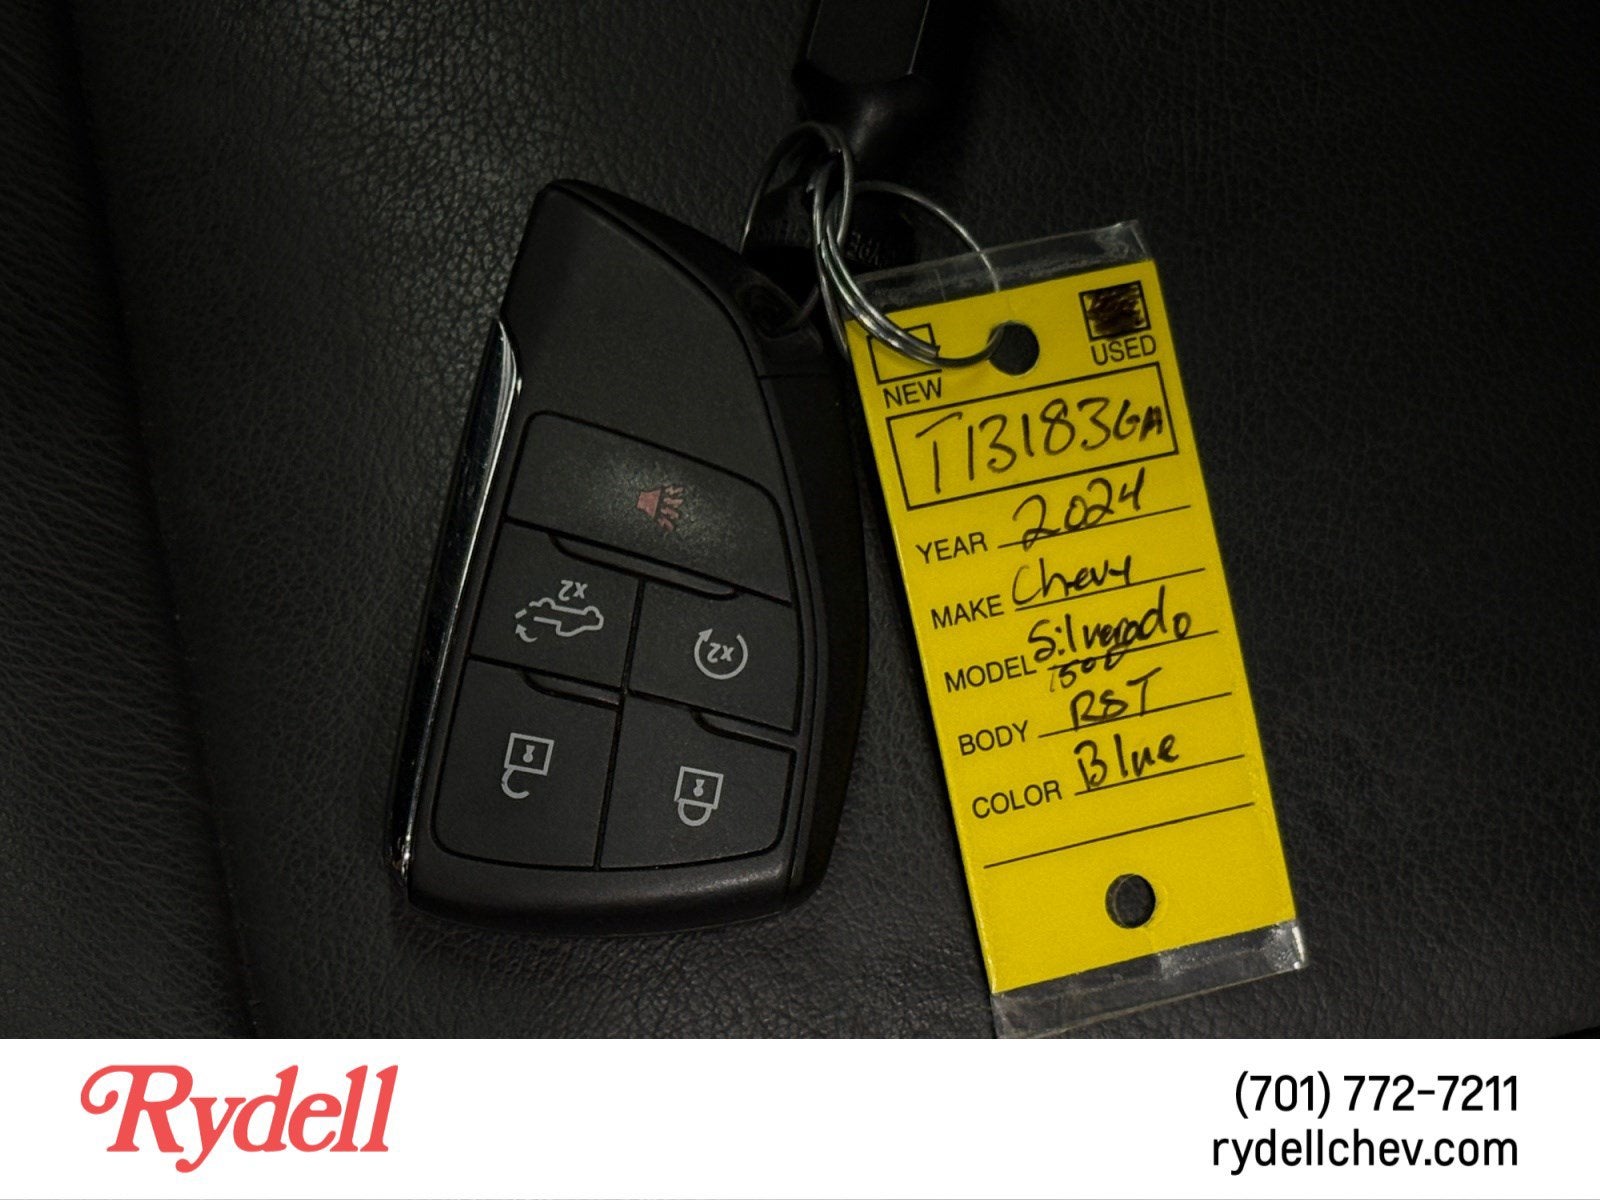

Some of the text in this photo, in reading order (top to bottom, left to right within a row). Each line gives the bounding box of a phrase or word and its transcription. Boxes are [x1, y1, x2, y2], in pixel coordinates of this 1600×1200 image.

[1091, 336, 1157, 367] USED
[882, 378, 943, 409] NEW
[1013, 468, 1146, 552] 2024
[916, 531, 989, 565] YEAR
[1011, 555, 1133, 604] Chevy
[931, 595, 1004, 629] MAKE
[1028, 585, 1192, 661] Silverado
[944, 655, 1038, 693] MODEL
[1071, 666, 1162, 730] RST
[959, 721, 1029, 756] BODY
[1074, 734, 1179, 791] Blue
[972, 780, 1063, 819] COLOR
